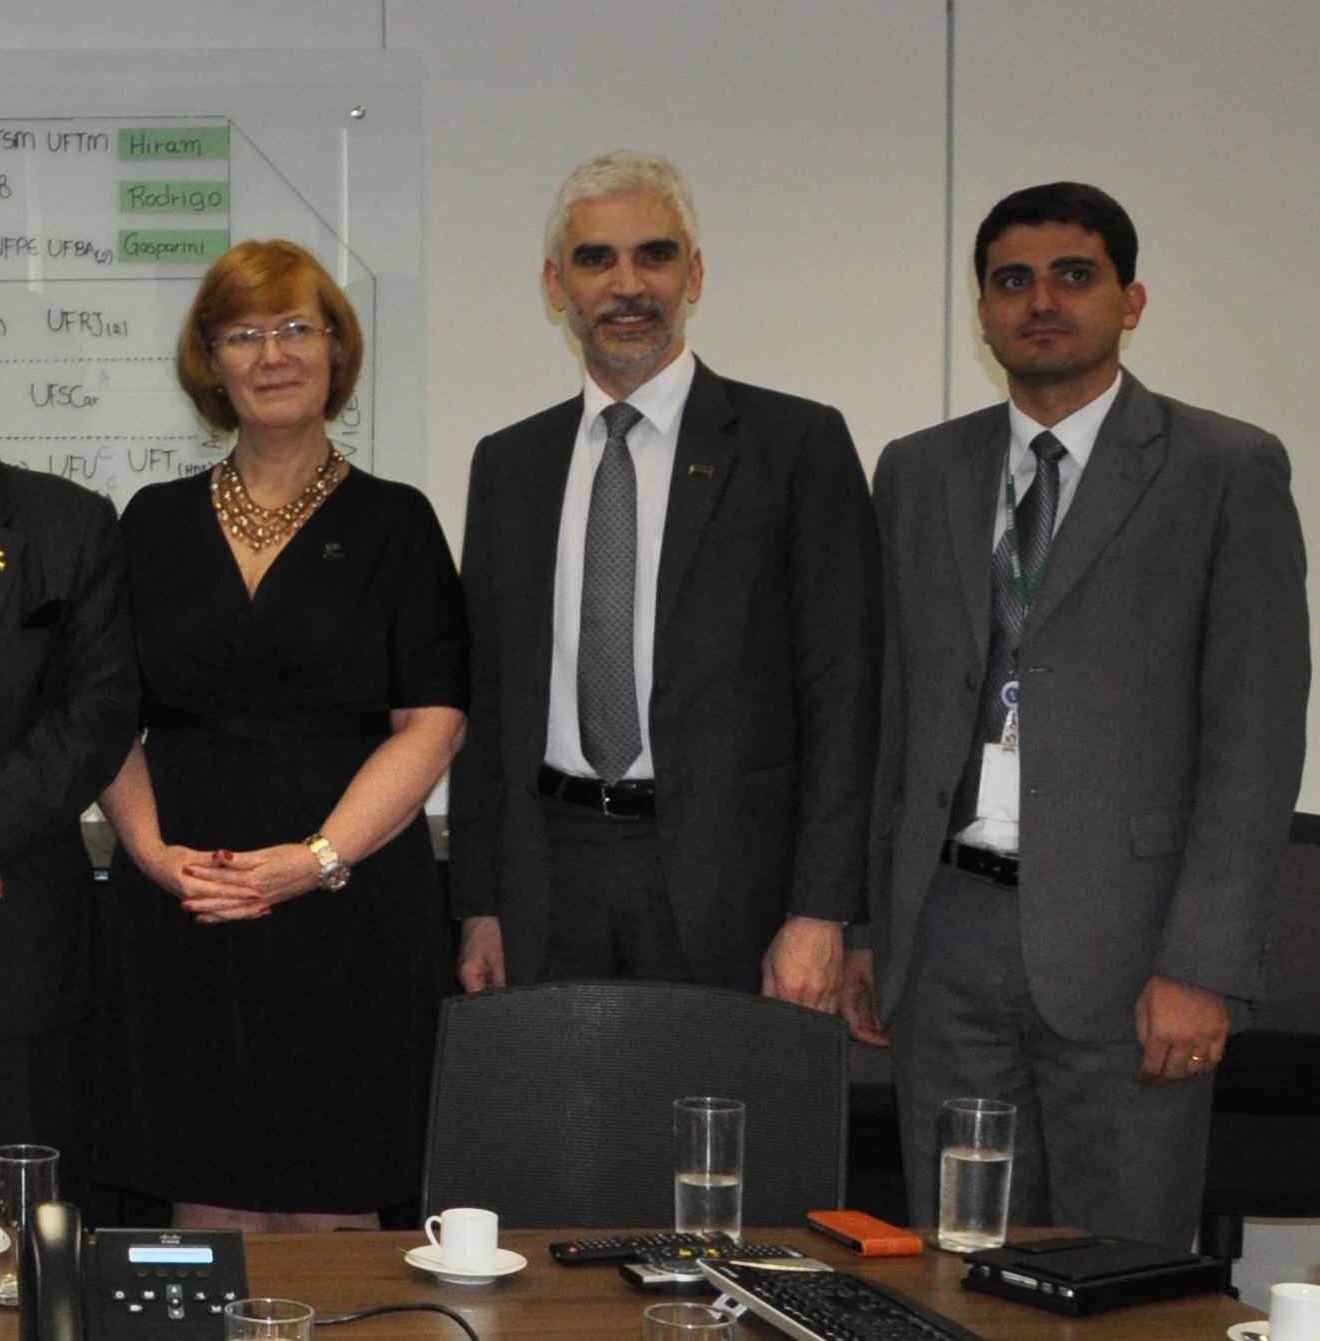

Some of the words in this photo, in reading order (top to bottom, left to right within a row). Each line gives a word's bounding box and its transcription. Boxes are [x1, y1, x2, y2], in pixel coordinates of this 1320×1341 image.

[47, 130, 109, 152] UFTM
[129, 133, 202, 156] Hiram
[128, 183, 223, 212] Rodrigo
[123, 232, 205, 260] Gasparini
[30, 382, 101, 408] UFSCar
